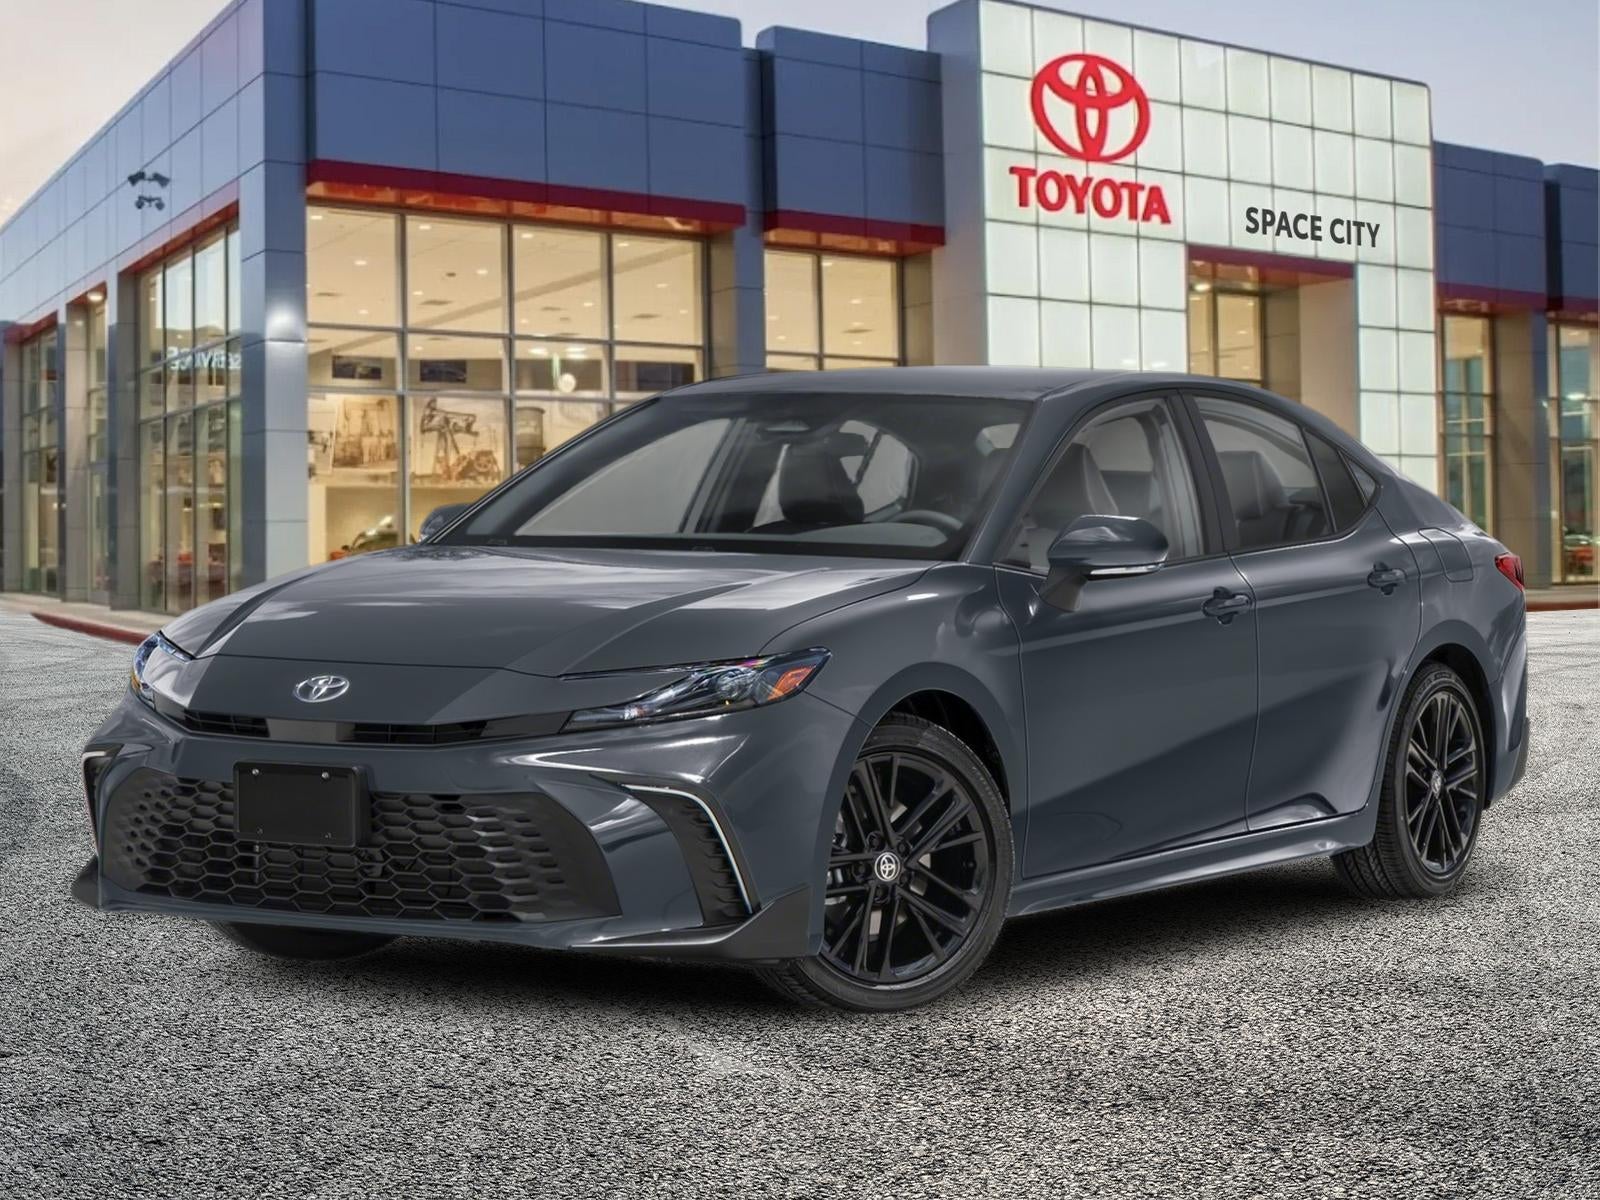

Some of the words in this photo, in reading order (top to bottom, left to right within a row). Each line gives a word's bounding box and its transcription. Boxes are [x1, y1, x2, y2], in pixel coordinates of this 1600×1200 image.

[1009, 167, 1171, 224] TOYOTA
[1245, 206, 1322, 241] SPACE
[1330, 218, 1381, 248] CITY
